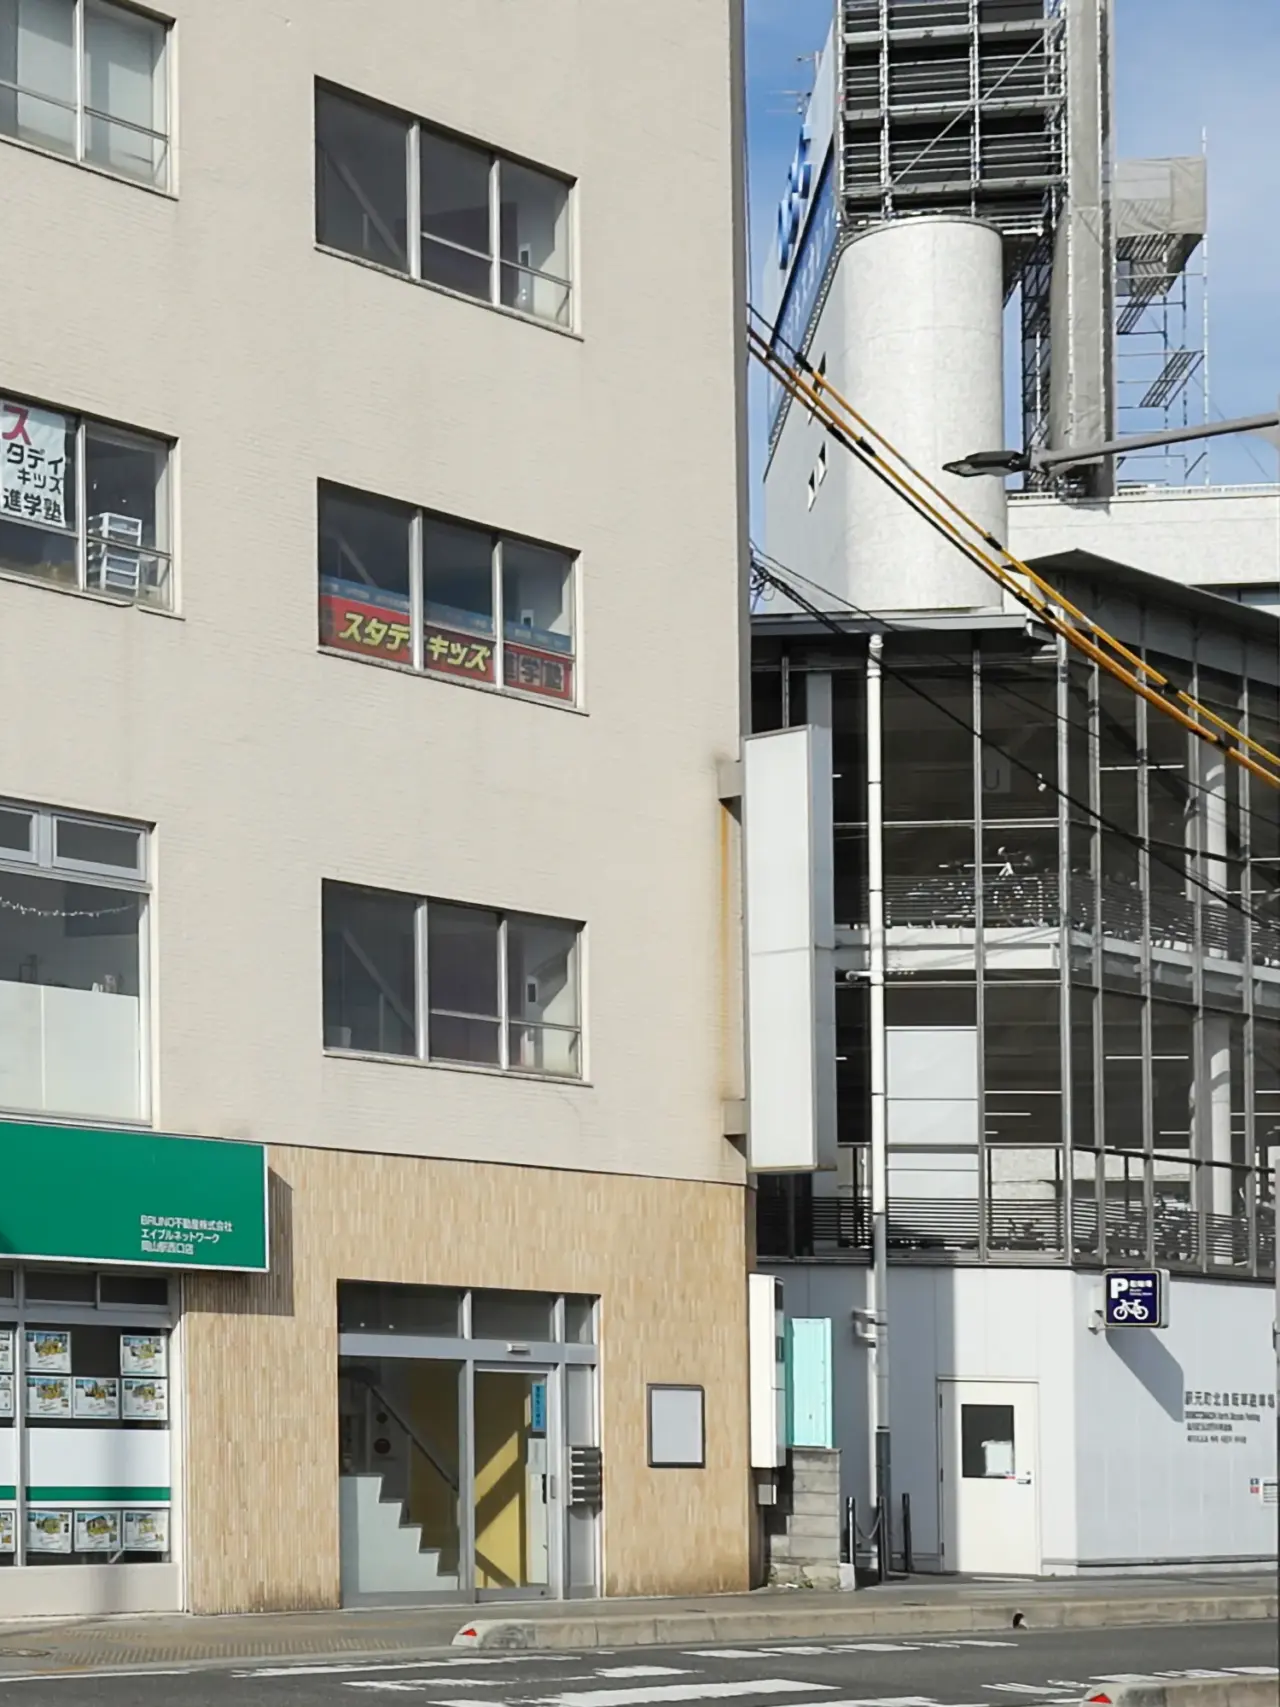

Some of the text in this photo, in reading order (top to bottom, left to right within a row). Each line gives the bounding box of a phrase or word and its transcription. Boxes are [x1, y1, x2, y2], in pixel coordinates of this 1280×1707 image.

[2, 487, 62, 524] 進学塾
[1110, 1278, 1129, 1299] P
